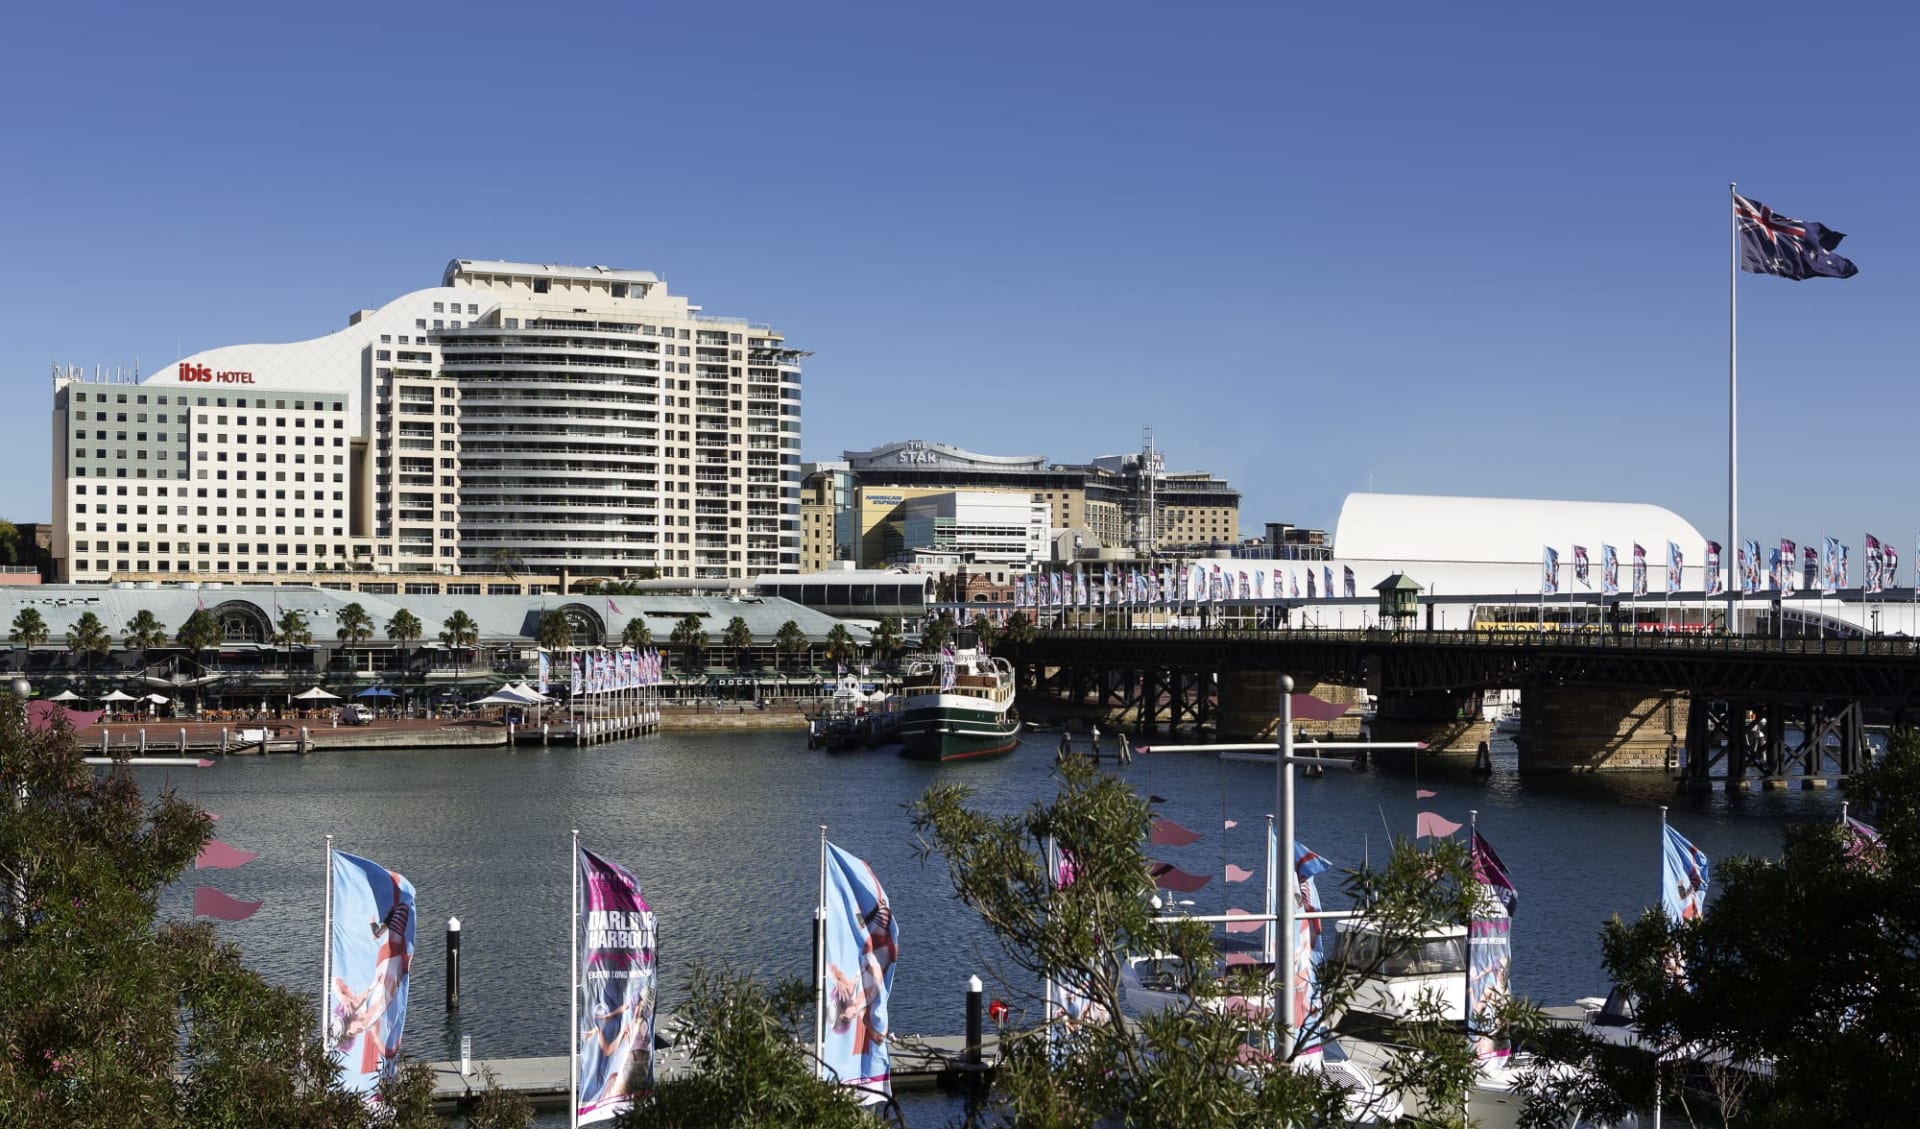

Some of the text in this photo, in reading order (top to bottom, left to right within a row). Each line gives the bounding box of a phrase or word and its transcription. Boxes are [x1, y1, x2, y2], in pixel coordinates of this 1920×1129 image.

[178, 362, 256, 384] ibis HOTEL
[899, 451, 937, 463] STAR
